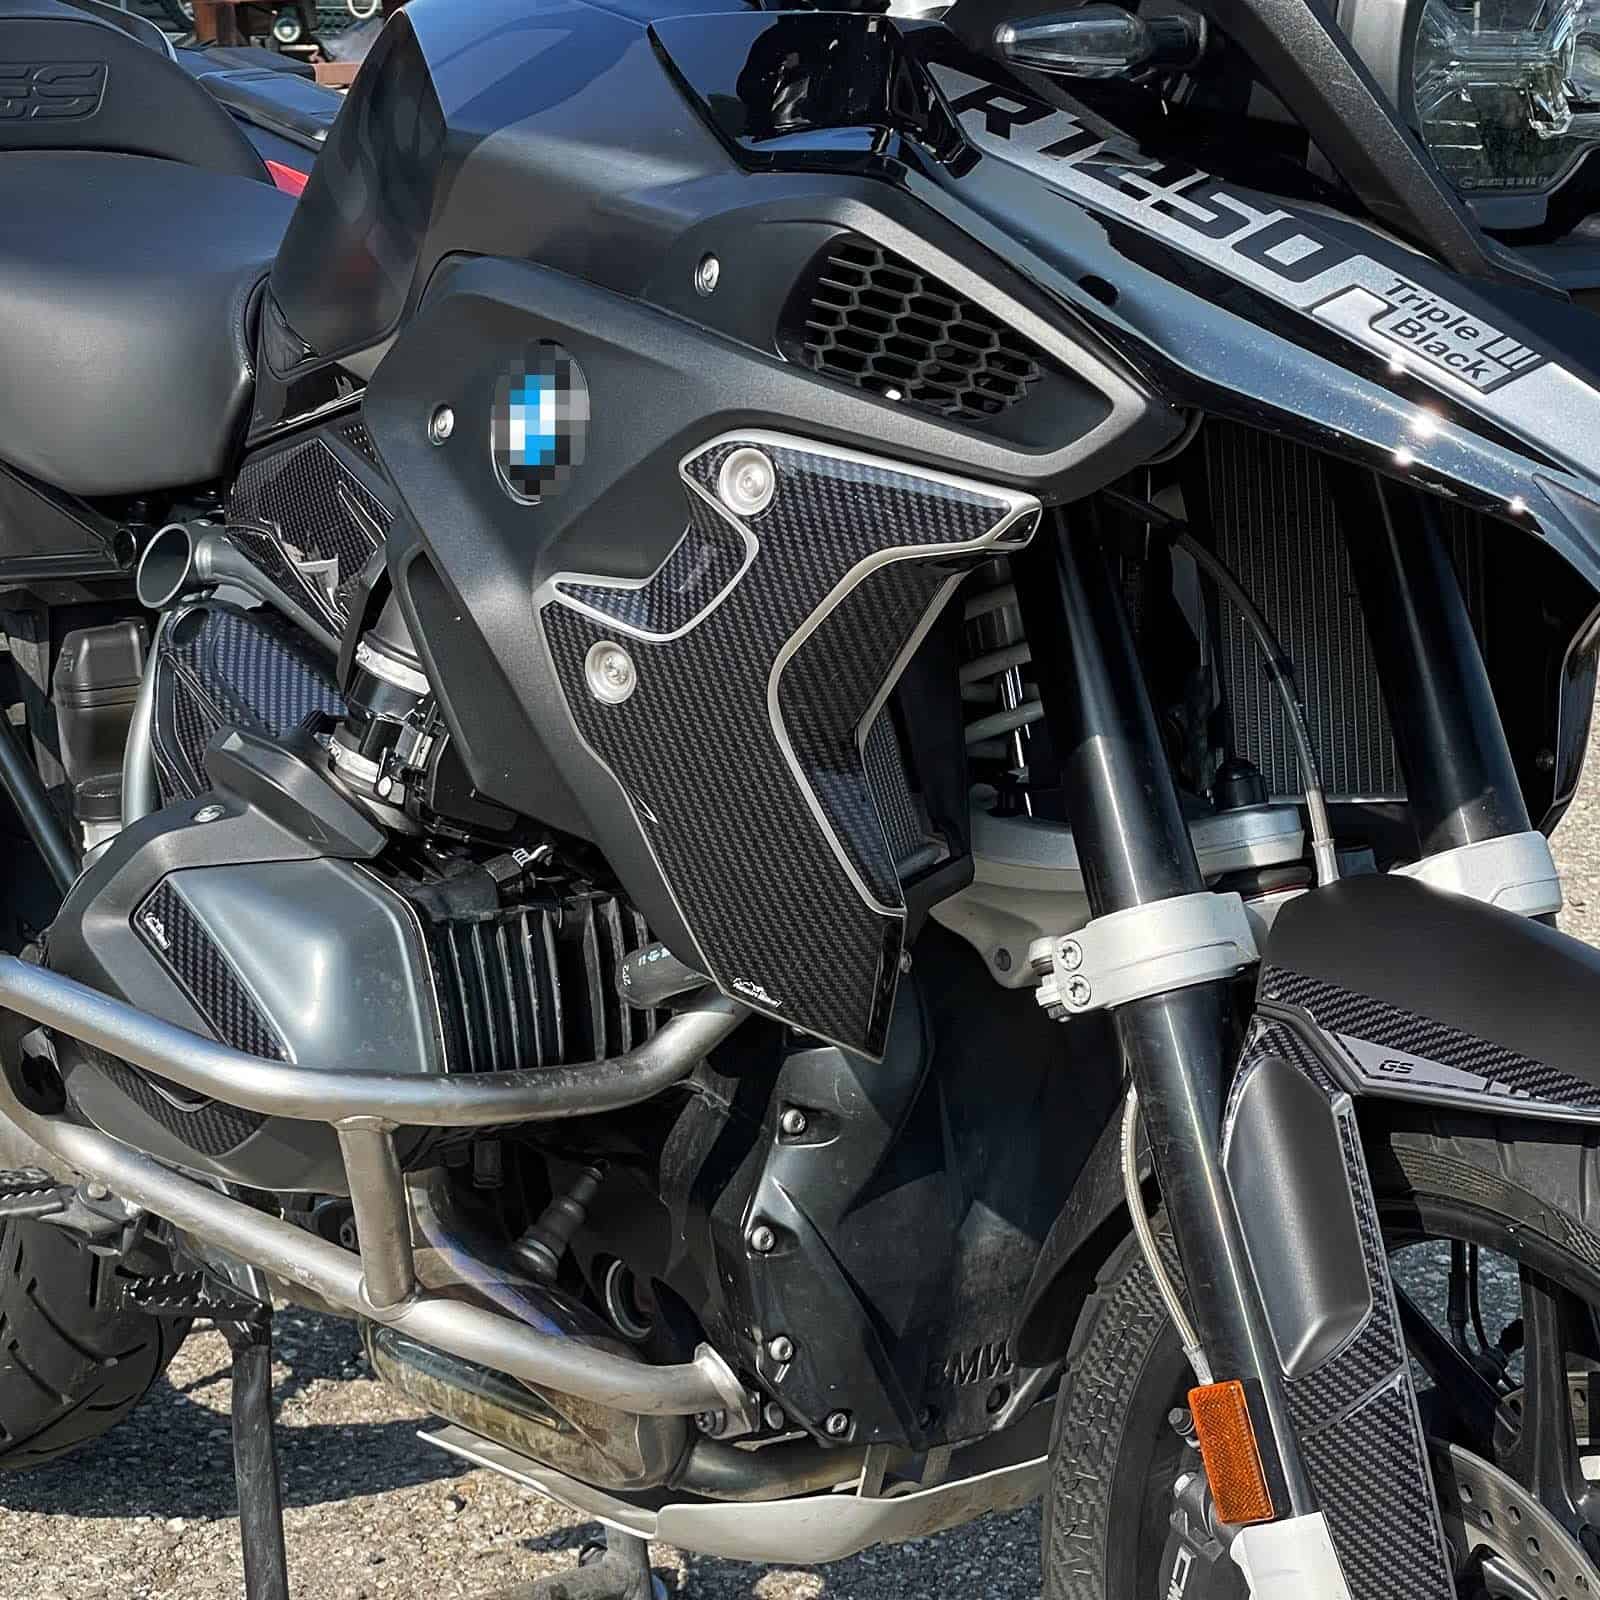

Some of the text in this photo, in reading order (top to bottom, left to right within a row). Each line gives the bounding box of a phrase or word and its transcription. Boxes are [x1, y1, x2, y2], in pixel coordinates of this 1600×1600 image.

[948, 84, 1344, 283] R1250
[1385, 278, 1480, 341] Triple
[1390, 317, 1491, 380] Black
[1379, 1059, 1414, 1074] GS
